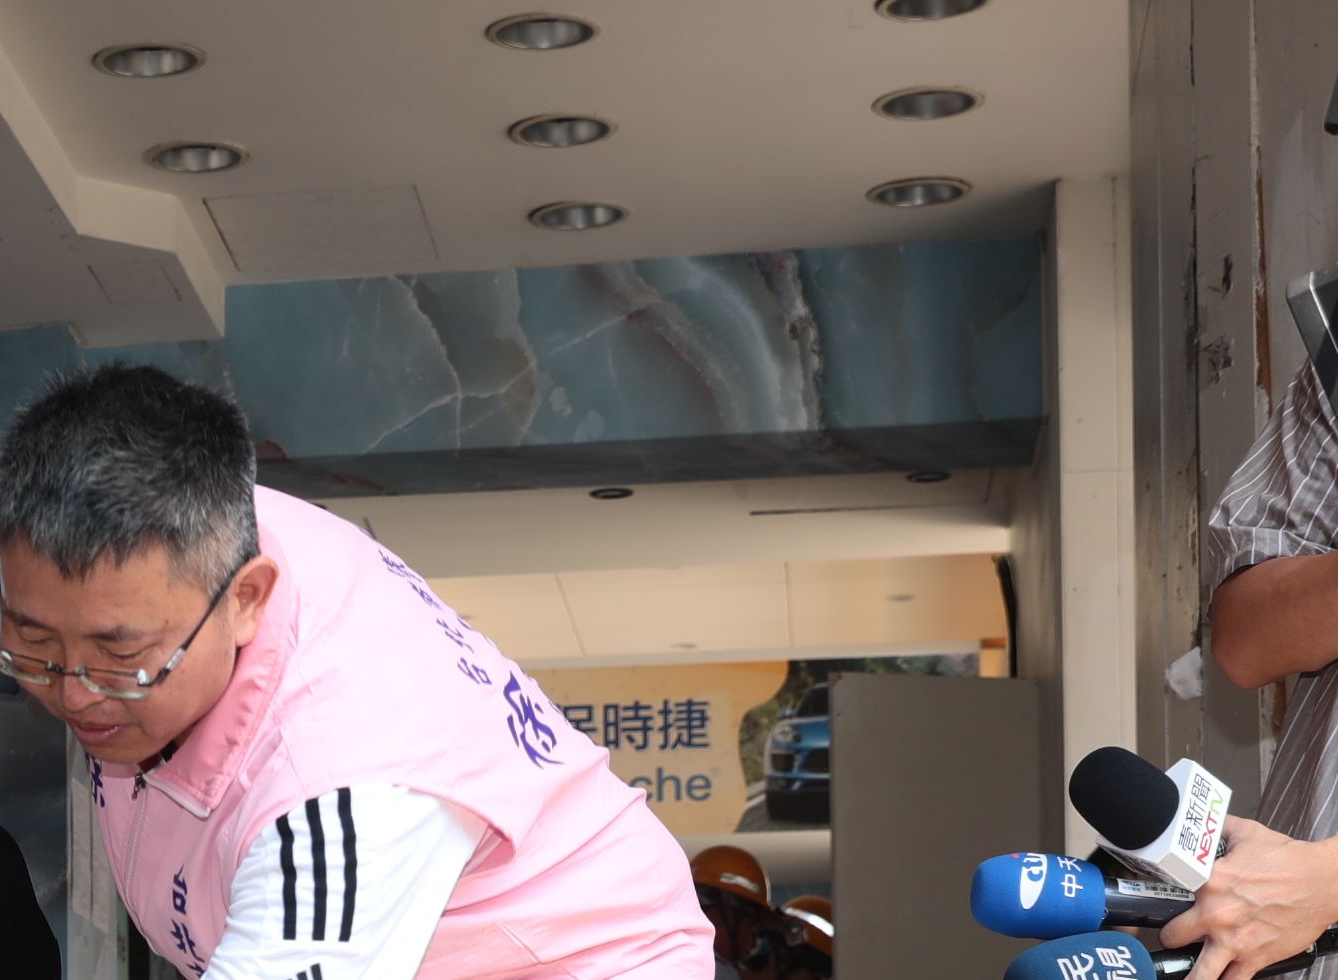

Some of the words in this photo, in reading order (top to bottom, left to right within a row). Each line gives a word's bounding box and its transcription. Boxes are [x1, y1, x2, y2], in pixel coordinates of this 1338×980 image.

[1177, 773, 1212, 857] 壹新聞
[1058, 856, 1084, 899] 中天
